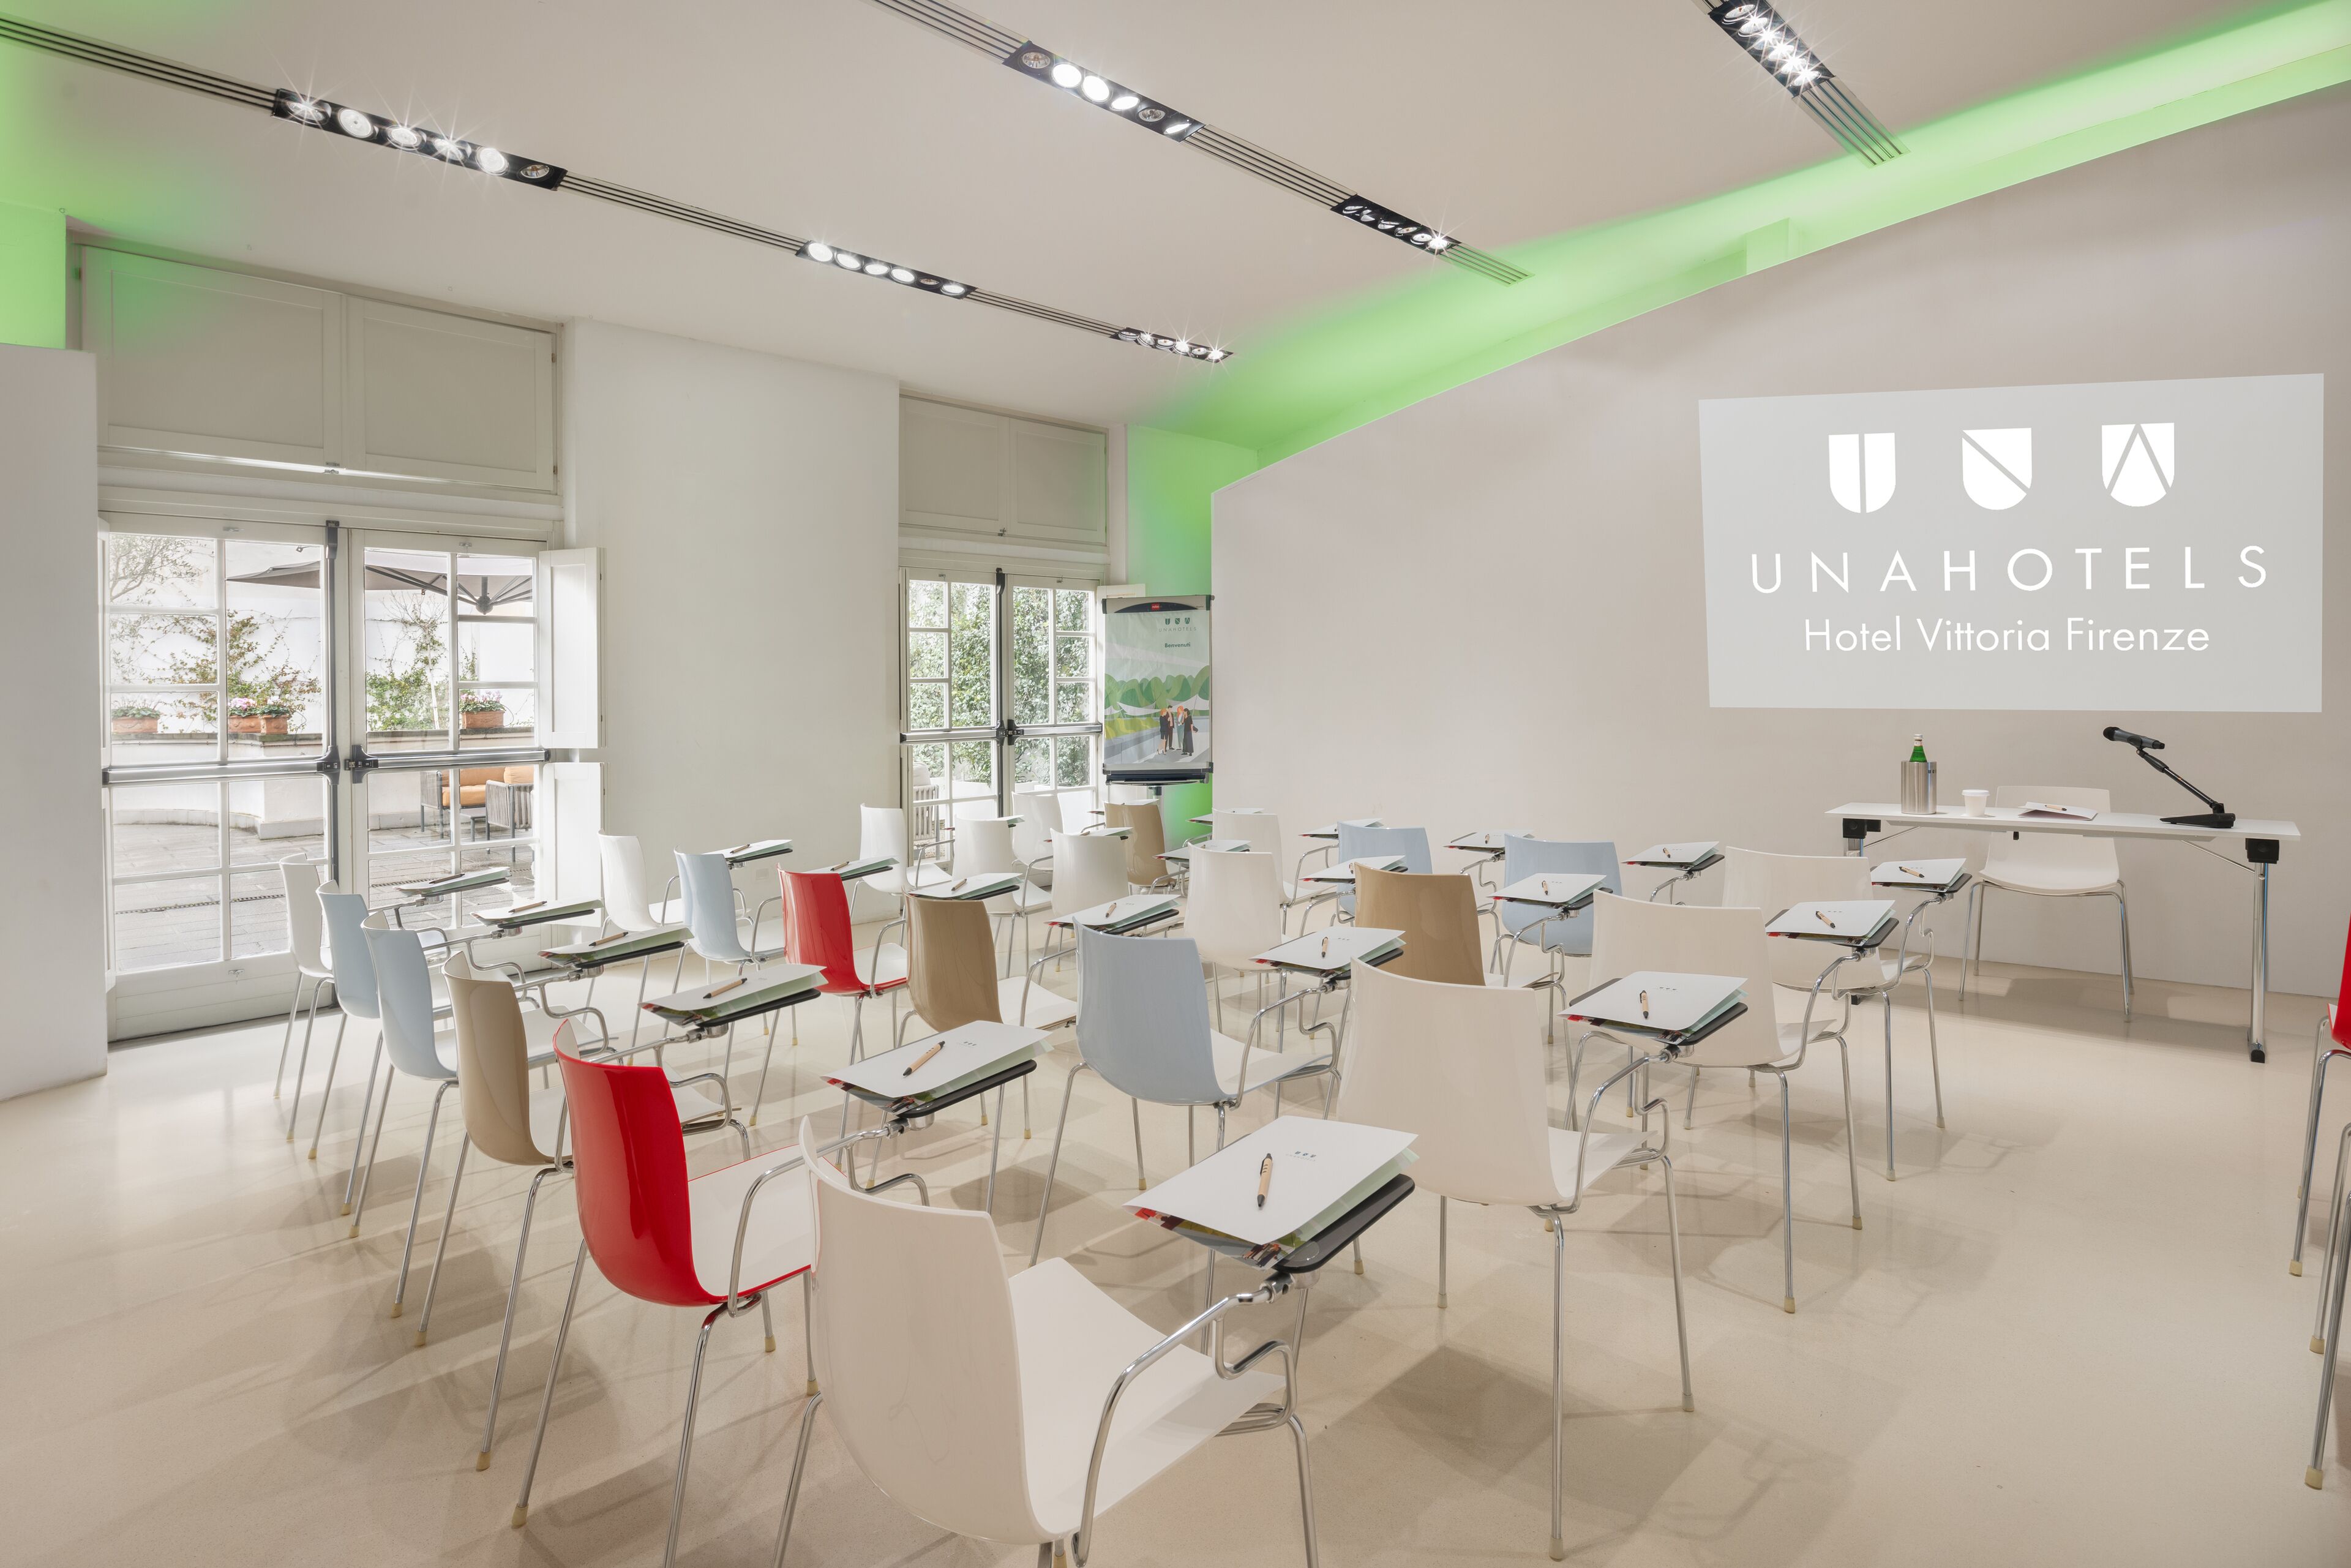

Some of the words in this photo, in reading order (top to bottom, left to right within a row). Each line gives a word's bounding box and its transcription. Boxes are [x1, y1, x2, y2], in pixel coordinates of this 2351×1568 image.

[1752, 546, 2267, 594] UNAHOTELS
[1805, 615, 1901, 651] Hotel
[1916, 618, 2049, 651] Vittoria
[2067, 617, 2210, 651] Firenze
